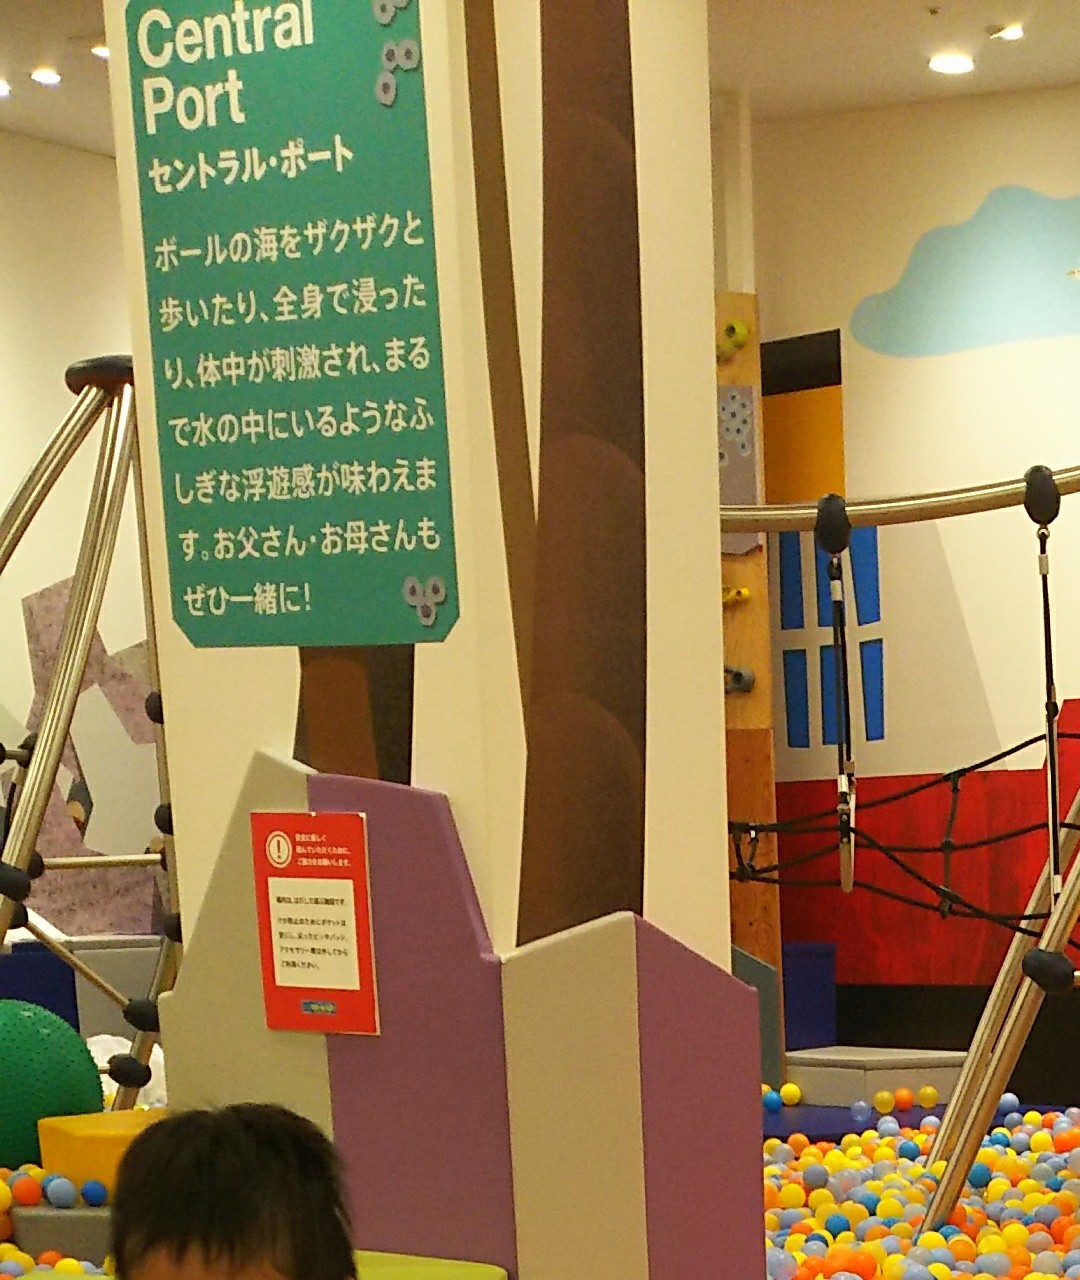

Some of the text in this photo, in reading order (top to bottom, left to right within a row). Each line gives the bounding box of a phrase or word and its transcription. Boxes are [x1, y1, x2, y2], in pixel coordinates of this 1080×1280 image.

[137, 0, 314, 68] Central
[142, 69, 246, 135] Port
[148, 134, 355, 194] セントラル・ポート
[155, 210, 425, 273] ボールの海をザクザクと
[159, 274, 427, 333] 歩いたり、全身で浸った
[165, 336, 431, 390] り、体中が刺激され、まる
[168, 397, 435, 447] で水の中にいるようなふ
[175, 457, 437, 505] しぎな浮遊感が味わえま
